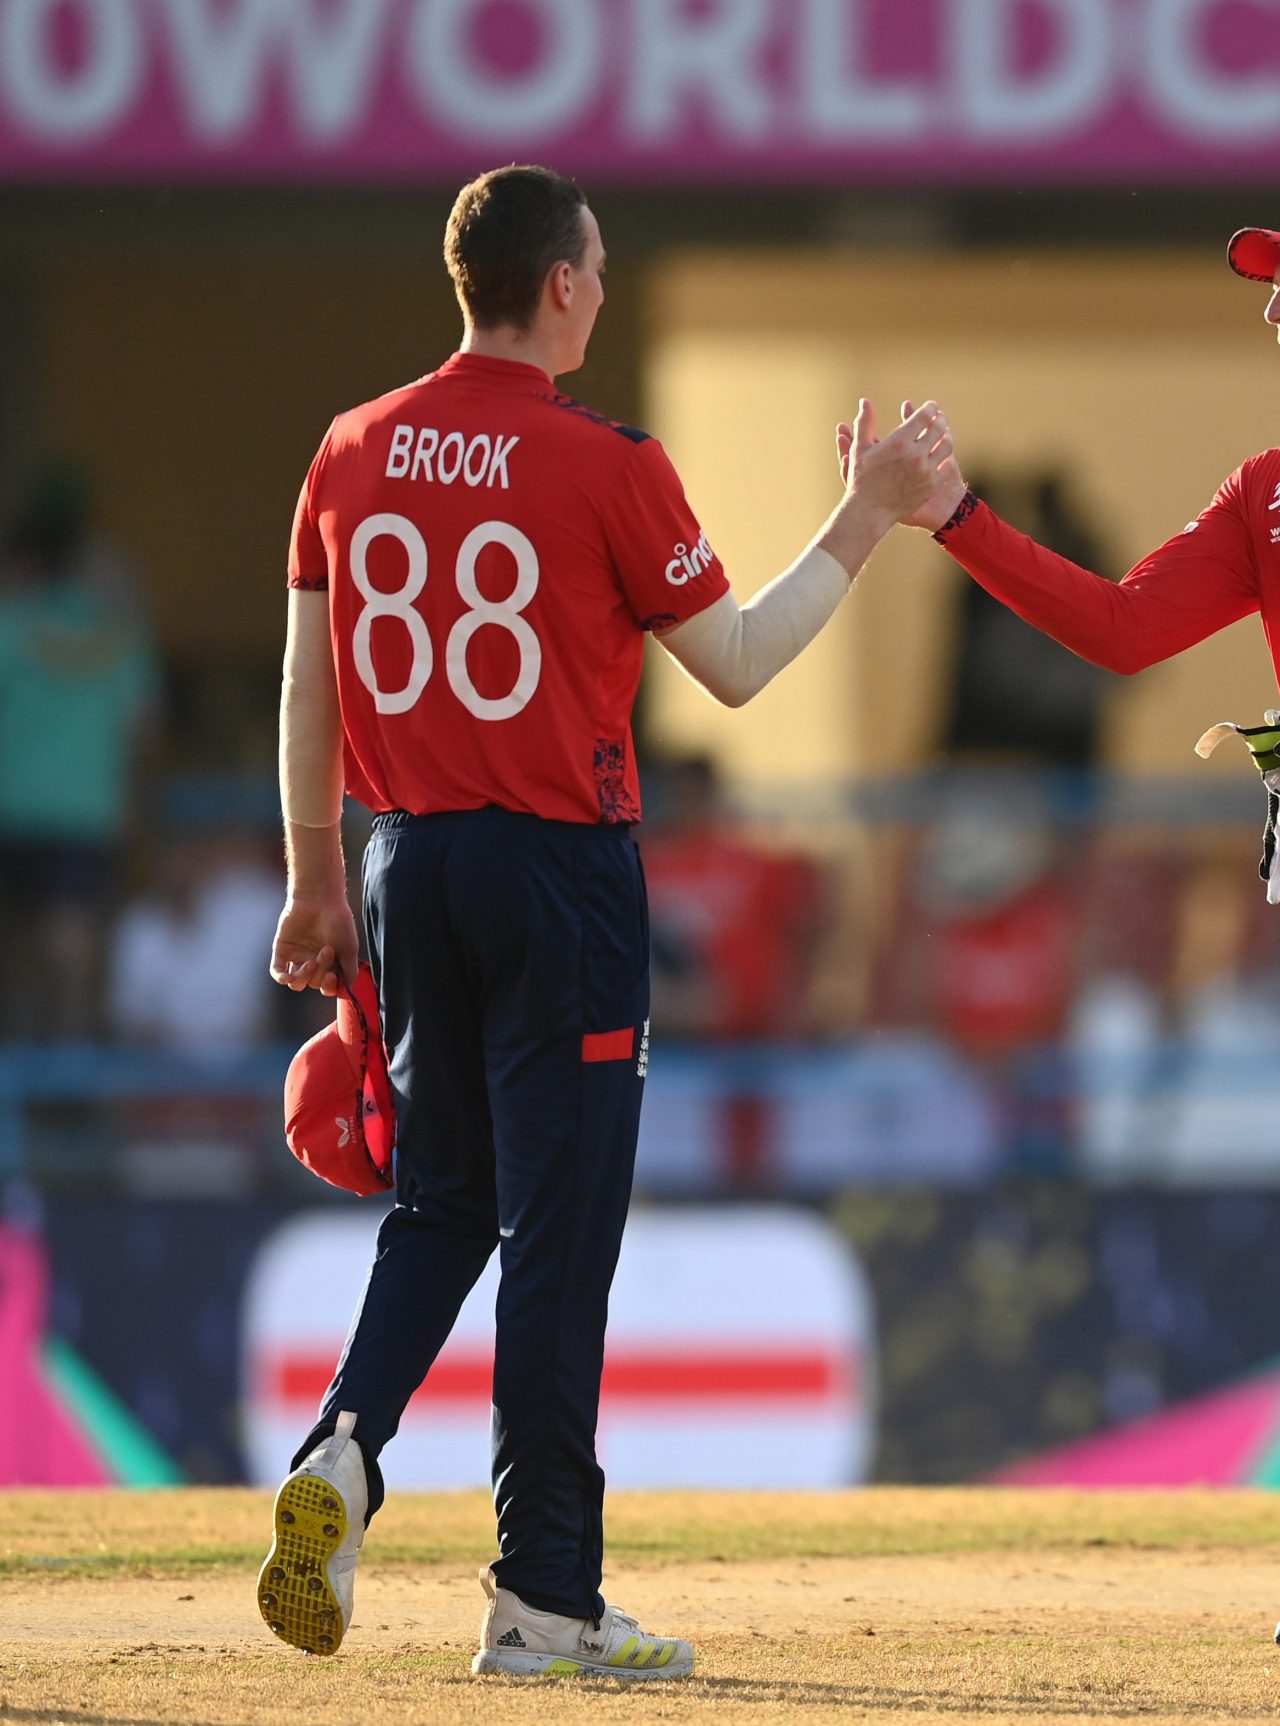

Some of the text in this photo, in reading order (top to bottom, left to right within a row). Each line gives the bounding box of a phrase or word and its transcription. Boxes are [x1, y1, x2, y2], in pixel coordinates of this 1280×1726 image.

[385, 424, 520, 489] BROOK
[349, 513, 542, 721] 88
[496, 1639, 527, 1648] adidas
